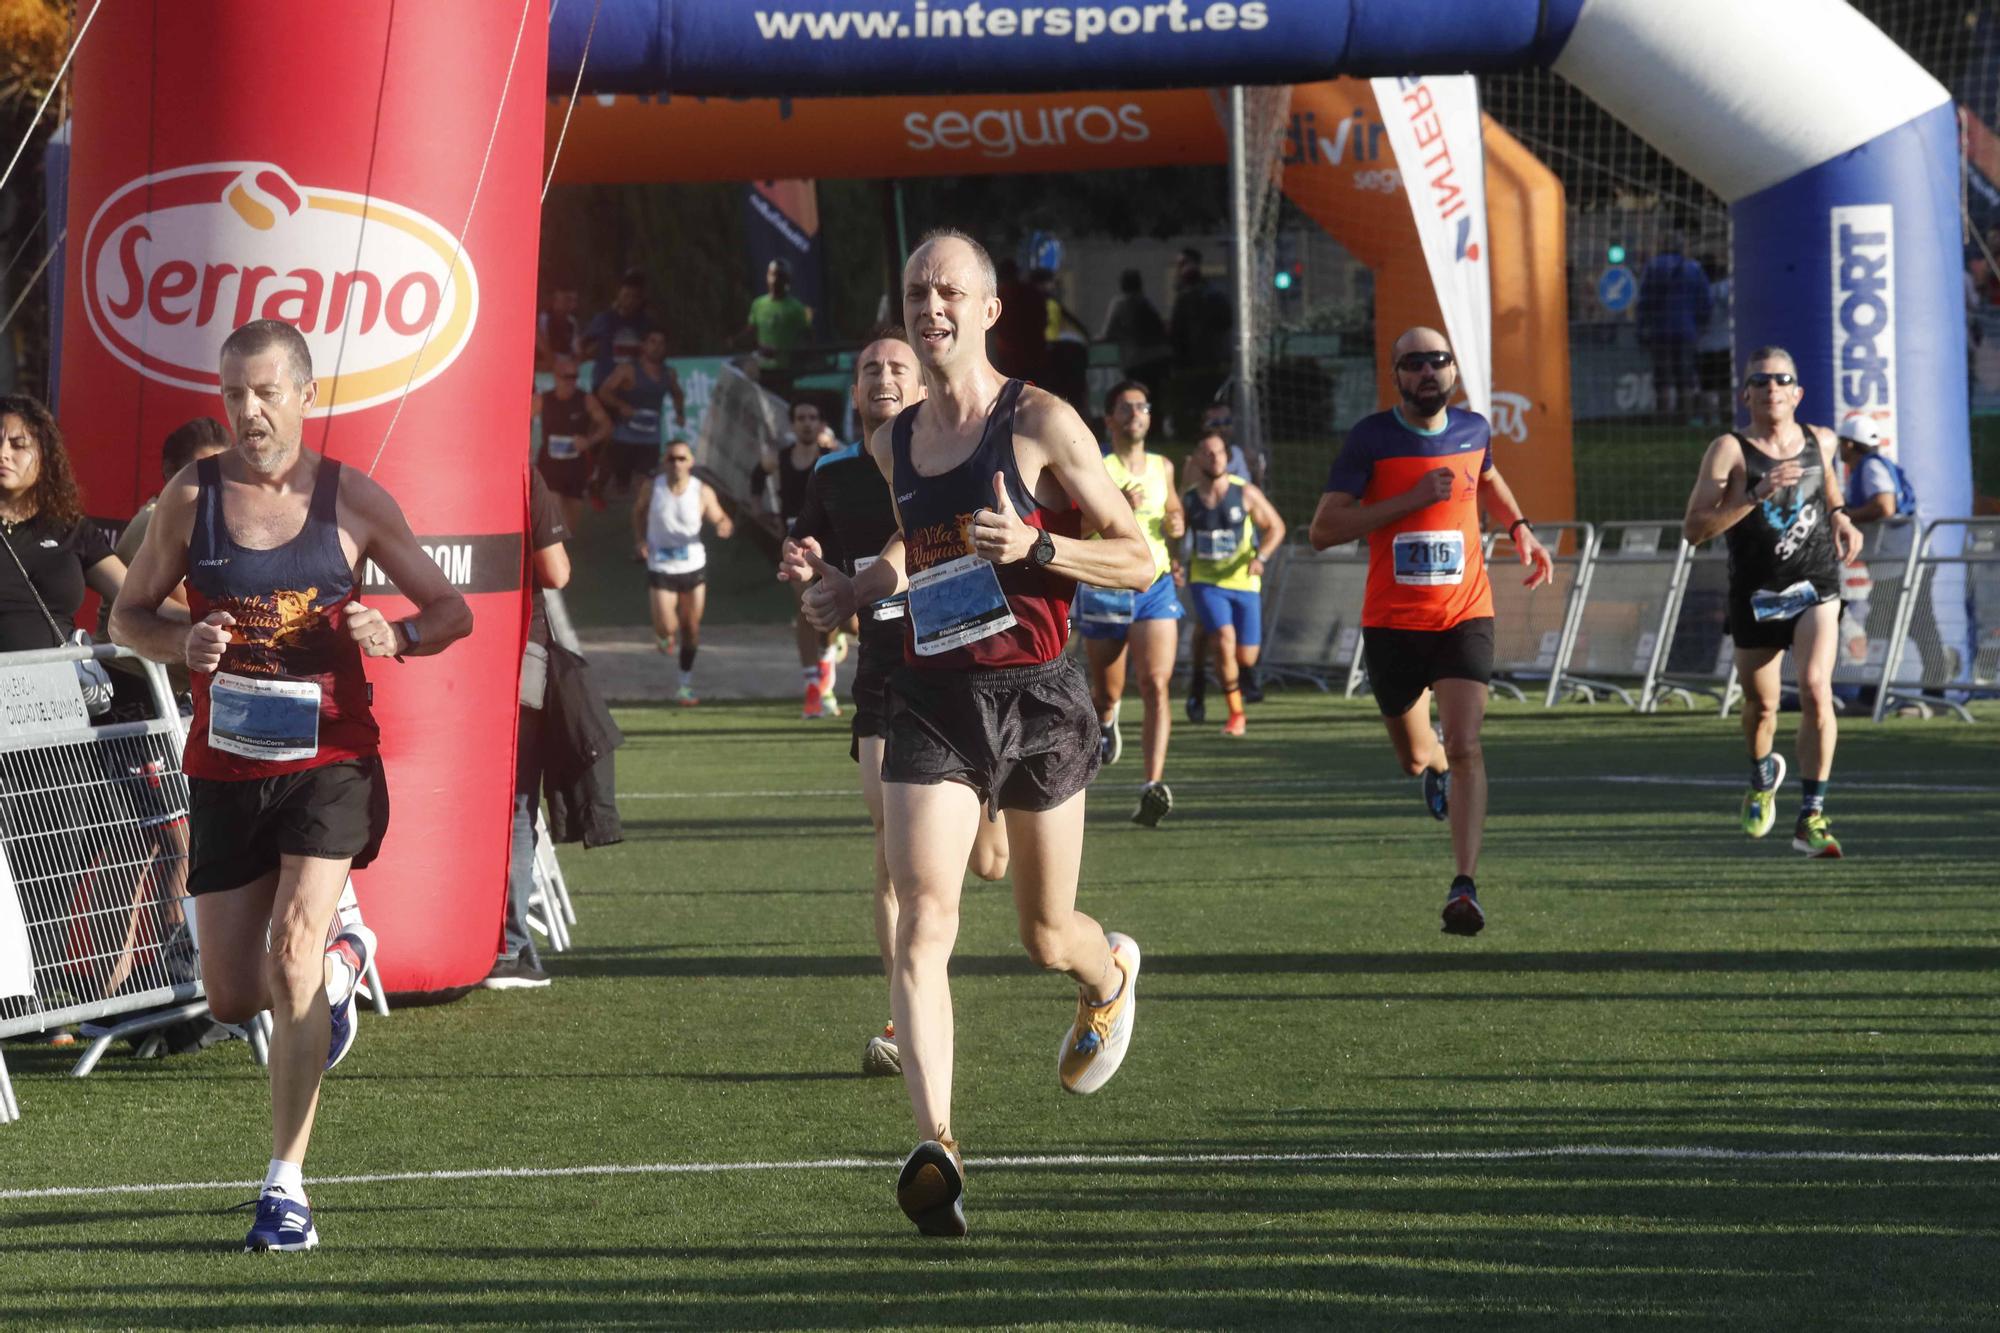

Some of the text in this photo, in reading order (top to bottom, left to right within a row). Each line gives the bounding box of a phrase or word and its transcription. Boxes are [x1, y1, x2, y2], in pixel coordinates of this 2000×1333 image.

[754, 0, 1269, 43] www.intersport.es
[904, 103, 1150, 157] seguros
[1353, 168, 1403, 194] seg
[105, 225, 440, 336] Serrano
[1408, 542, 1450, 564] 2116
